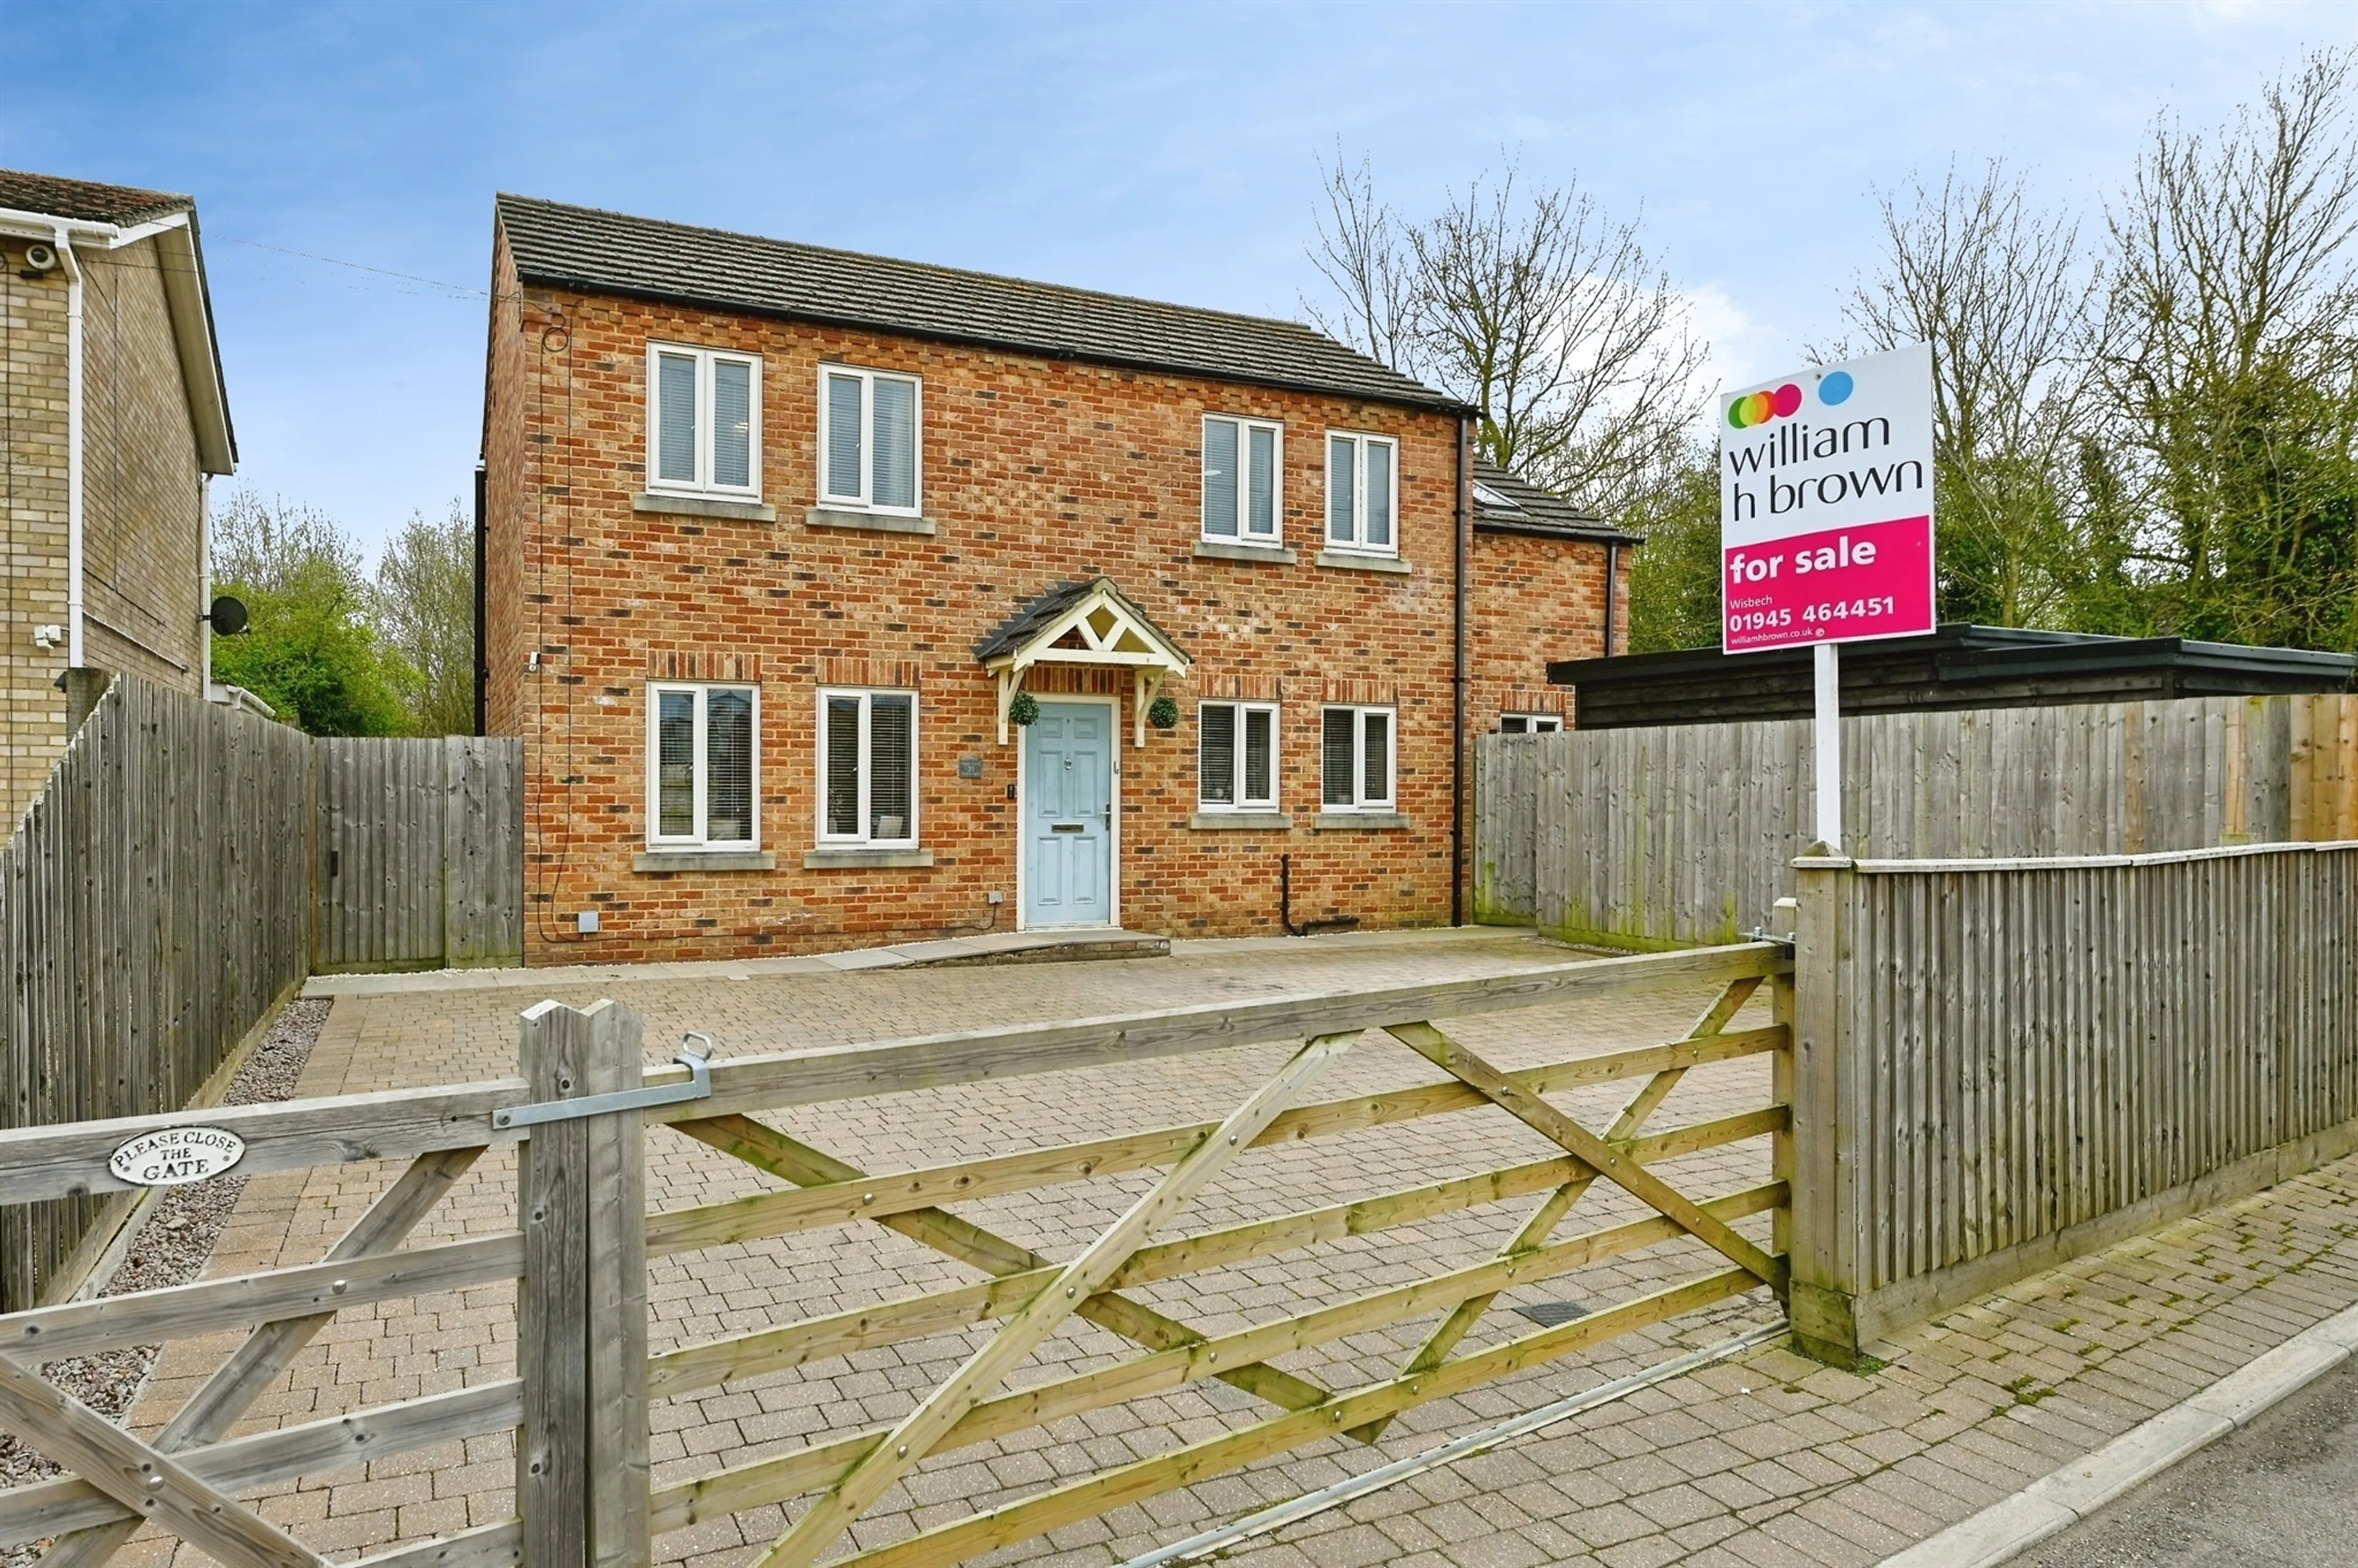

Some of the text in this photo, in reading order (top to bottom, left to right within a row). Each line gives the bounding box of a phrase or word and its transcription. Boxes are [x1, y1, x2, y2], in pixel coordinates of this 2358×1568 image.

[1729, 417, 1889, 476] william
[1733, 460, 1923, 521] h brown
[1729, 535, 1877, 584] for sale
[1729, 595, 1773, 610] Wisbech
[1729, 596, 1894, 632] 01945 464451
[1730, 627, 1813, 645] williamhbrown.co.uk
[113, 1131, 237, 1167] PLEASE CLOSE
[160, 1147, 192, 1160] THE
[143, 1159, 209, 1181] GATE
